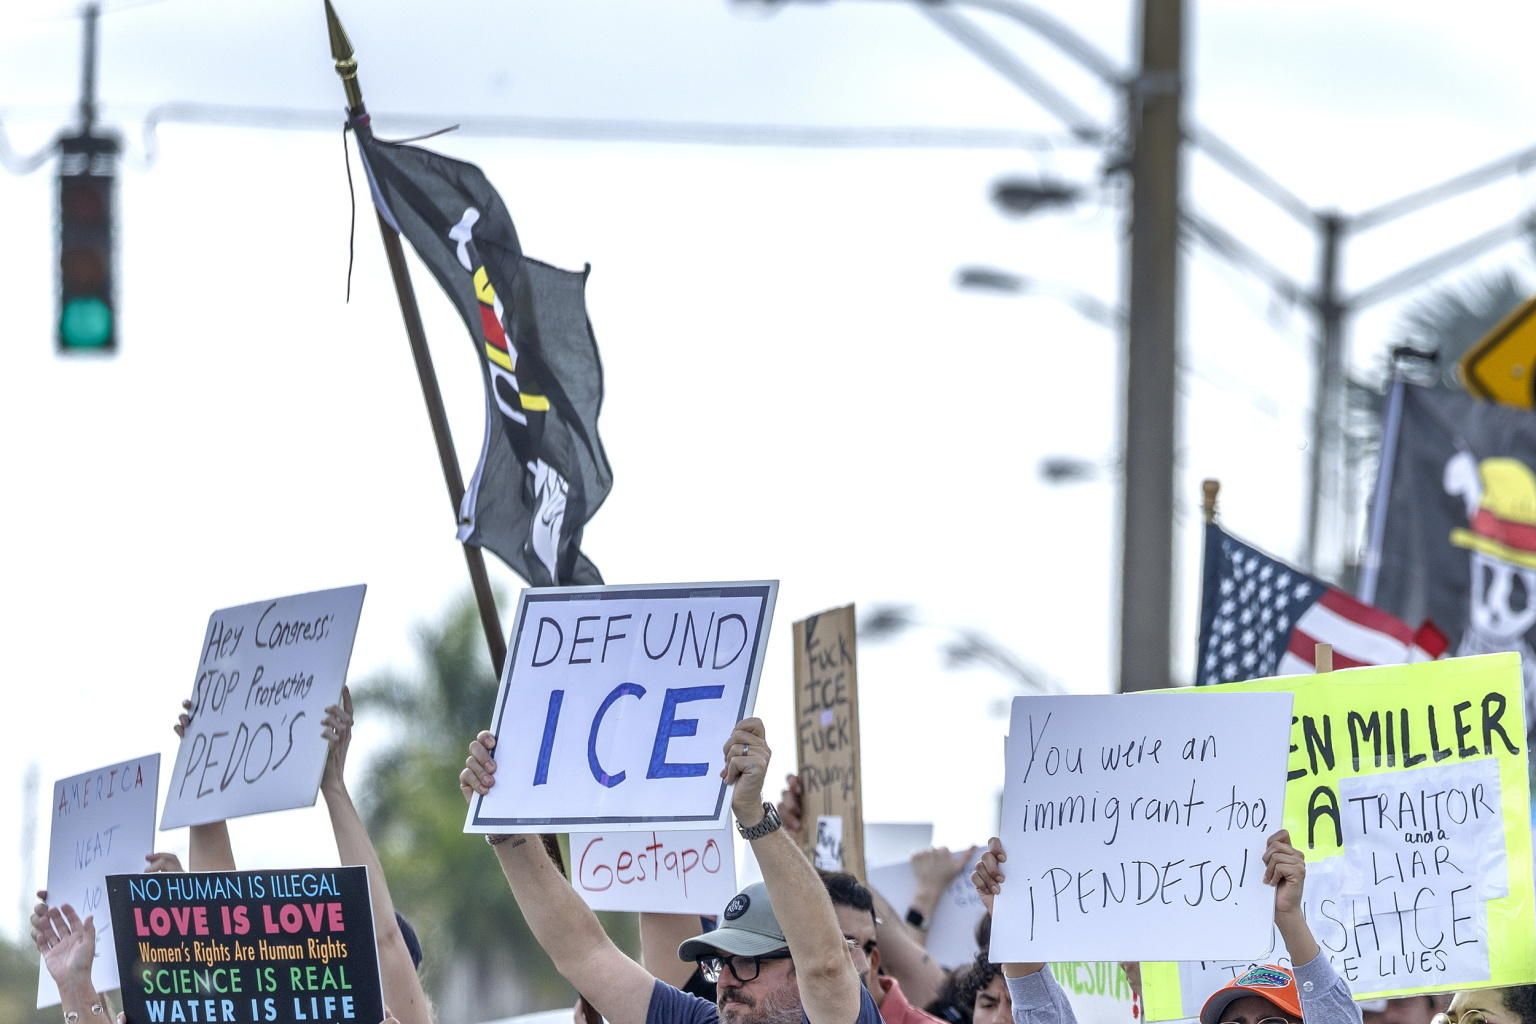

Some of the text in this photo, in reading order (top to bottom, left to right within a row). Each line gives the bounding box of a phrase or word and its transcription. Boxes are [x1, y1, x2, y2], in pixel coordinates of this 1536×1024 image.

[203, 620, 244, 665] Hey
[531, 610, 748, 671] DEFUND
[187, 664, 314, 725] STOP Protecting
[533, 682, 725, 788] ICE
[1023, 711, 1217, 784] You were an
[1347, 691, 1521, 773] MILLER
[179, 711, 306, 800] PEDO'S
[58, 763, 144, 818] AMERICA
[1307, 783, 1496, 850] A TRAITOR
[1405, 830, 1450, 845] and a
[129, 873, 341, 901] NO HUMAN IS ILLEGAL
[1372, 845, 1464, 886] LIAR
[134, 903, 345, 937] LOVE IS LOVE
[138, 940, 190, 963] Women's
[194, 939, 230, 967] Rights
[235, 941, 255, 961] Are
[259, 938, 304, 960] Human
[308, 936, 348, 964] Rights
[1379, 949, 1447, 977] LIVES
[142, 965, 352, 995] SCIENCE IS REAL
[145, 996, 355, 1023] WATER IS LIFE
